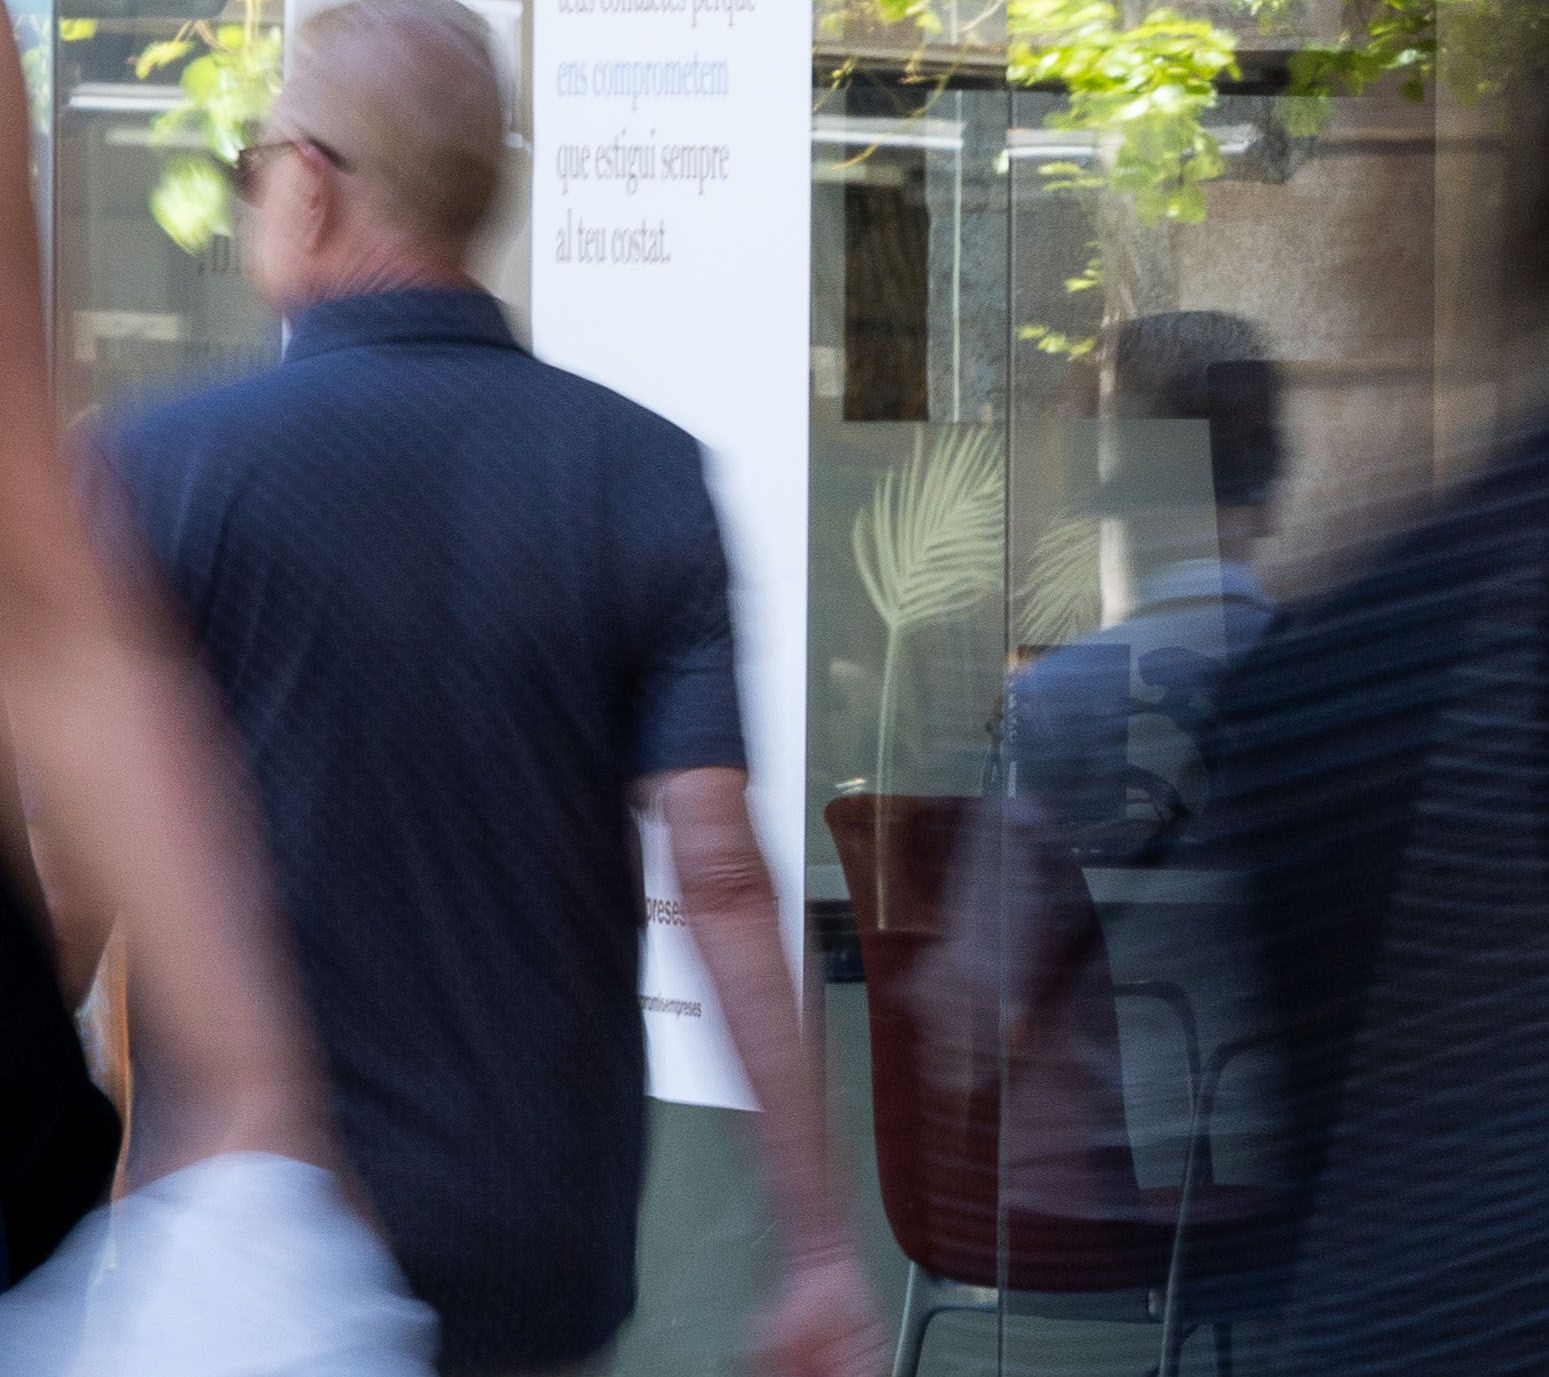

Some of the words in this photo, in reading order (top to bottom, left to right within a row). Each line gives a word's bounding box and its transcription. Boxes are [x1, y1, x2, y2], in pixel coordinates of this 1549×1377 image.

[557, 60, 588, 96] ens
[593, 50, 730, 111] comprometem
[556, 143, 590, 195] que
[595, 127, 656, 195] estigui
[660, 143, 730, 195] sempre
[556, 207, 573, 263] al
[577, 218, 606, 263] teu
[611, 218, 671, 264] costat.
